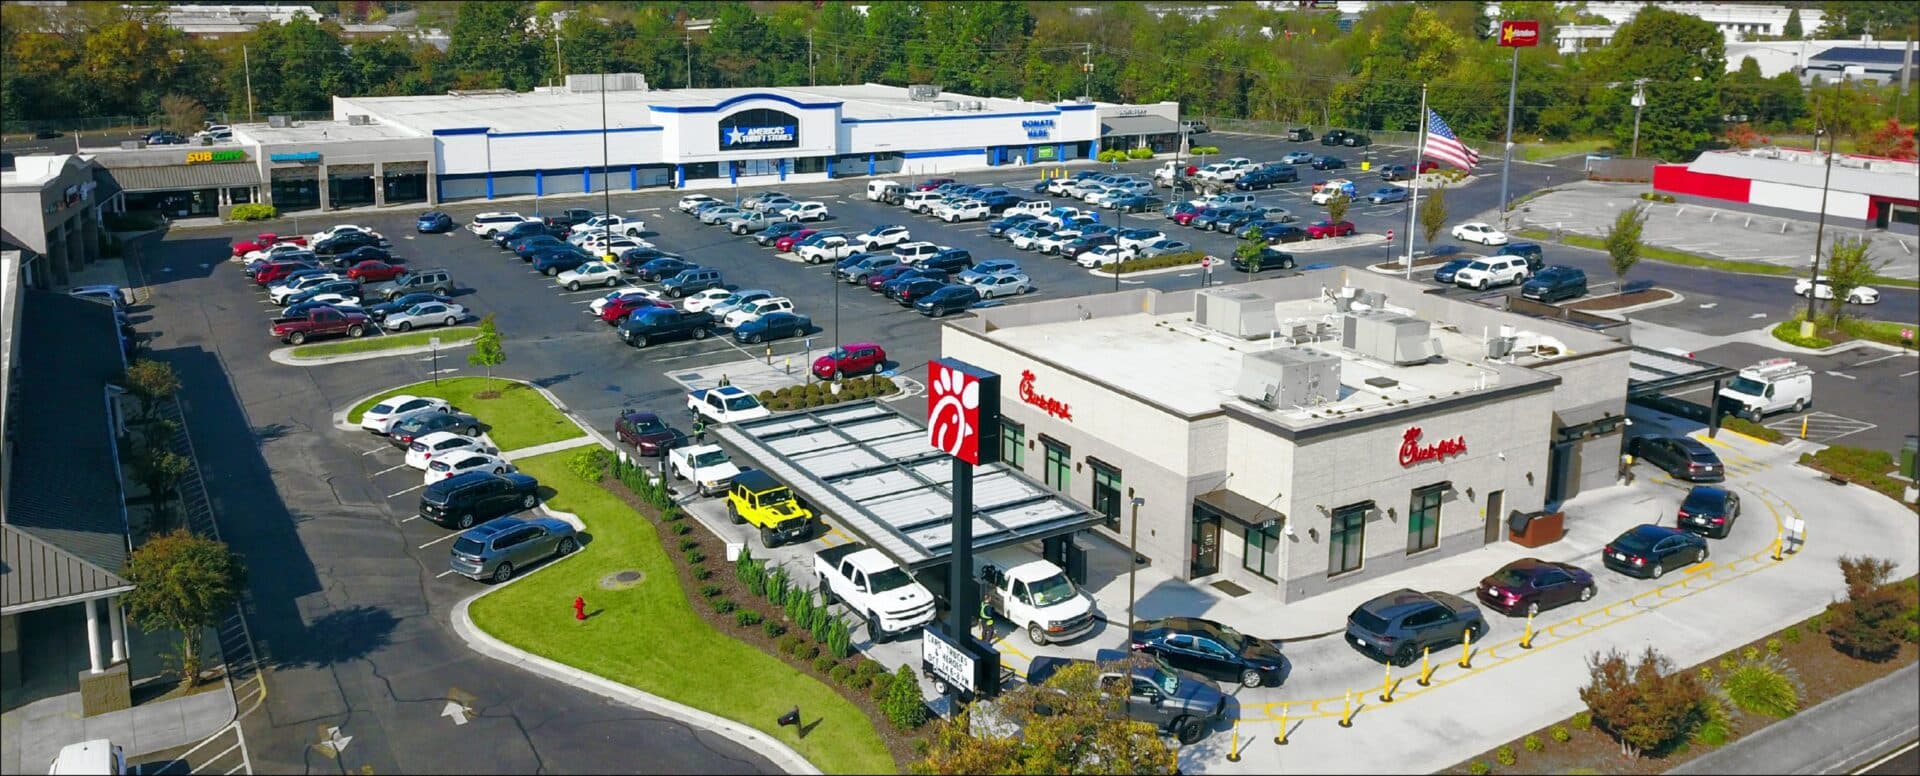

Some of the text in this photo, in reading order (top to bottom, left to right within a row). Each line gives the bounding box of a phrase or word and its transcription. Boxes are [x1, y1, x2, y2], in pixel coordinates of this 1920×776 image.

[1022, 120, 1055, 128] DONATE
[742, 133, 793, 143] THRIFT STORES
[1028, 129, 1049, 138] HERE
[186, 150, 246, 163] SUBWAY
[927, 634, 968, 666] CARS TRUCKS
[943, 654, 963, 672] HEROES
